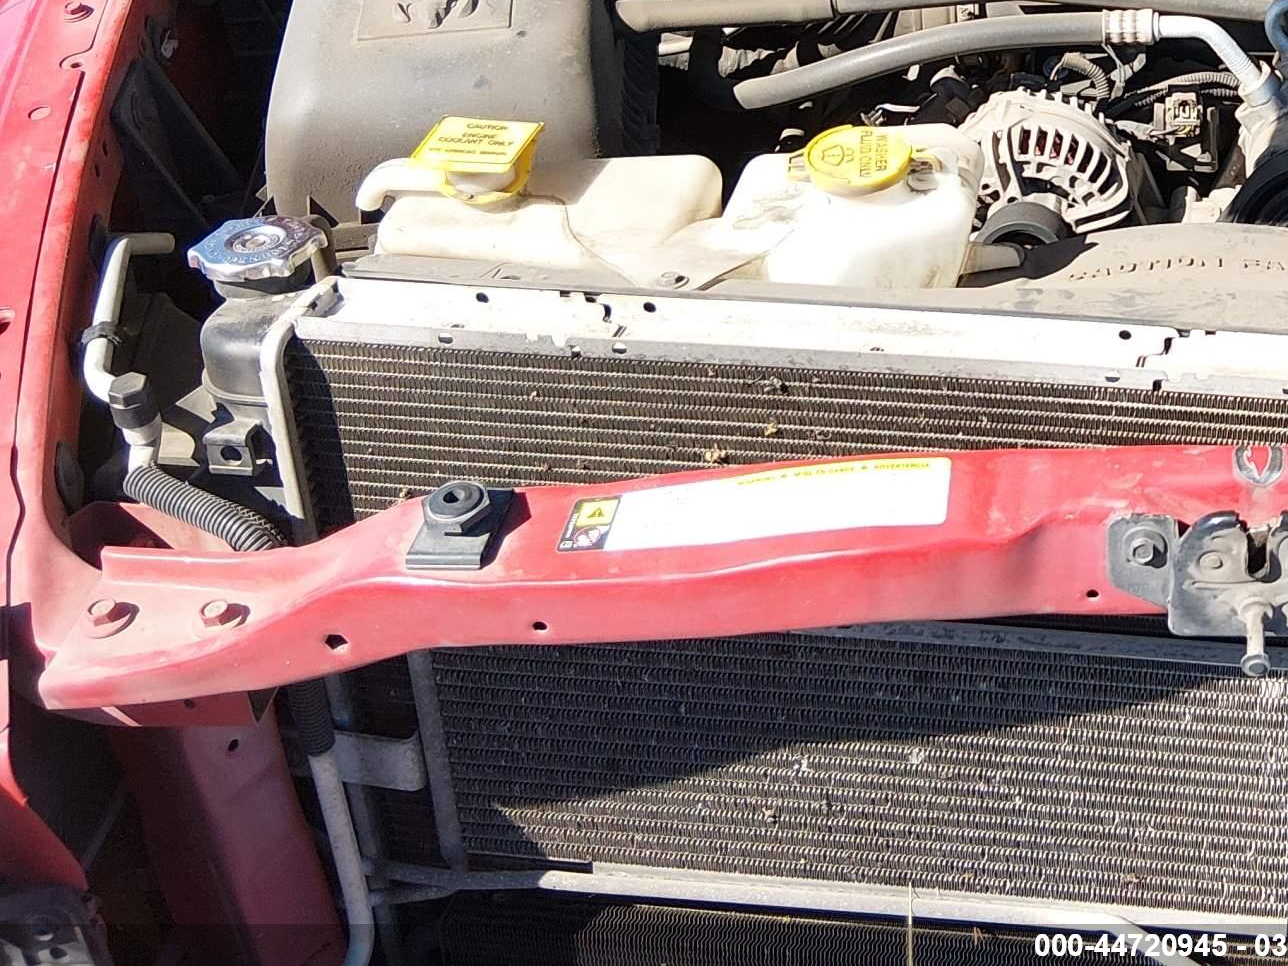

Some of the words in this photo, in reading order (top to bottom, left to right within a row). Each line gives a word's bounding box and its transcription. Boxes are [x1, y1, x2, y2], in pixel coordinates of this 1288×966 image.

[466, 123, 509, 131] CAUTION
[461, 132, 498, 140] ENGINE
[875, 134, 888, 172] WASHER
